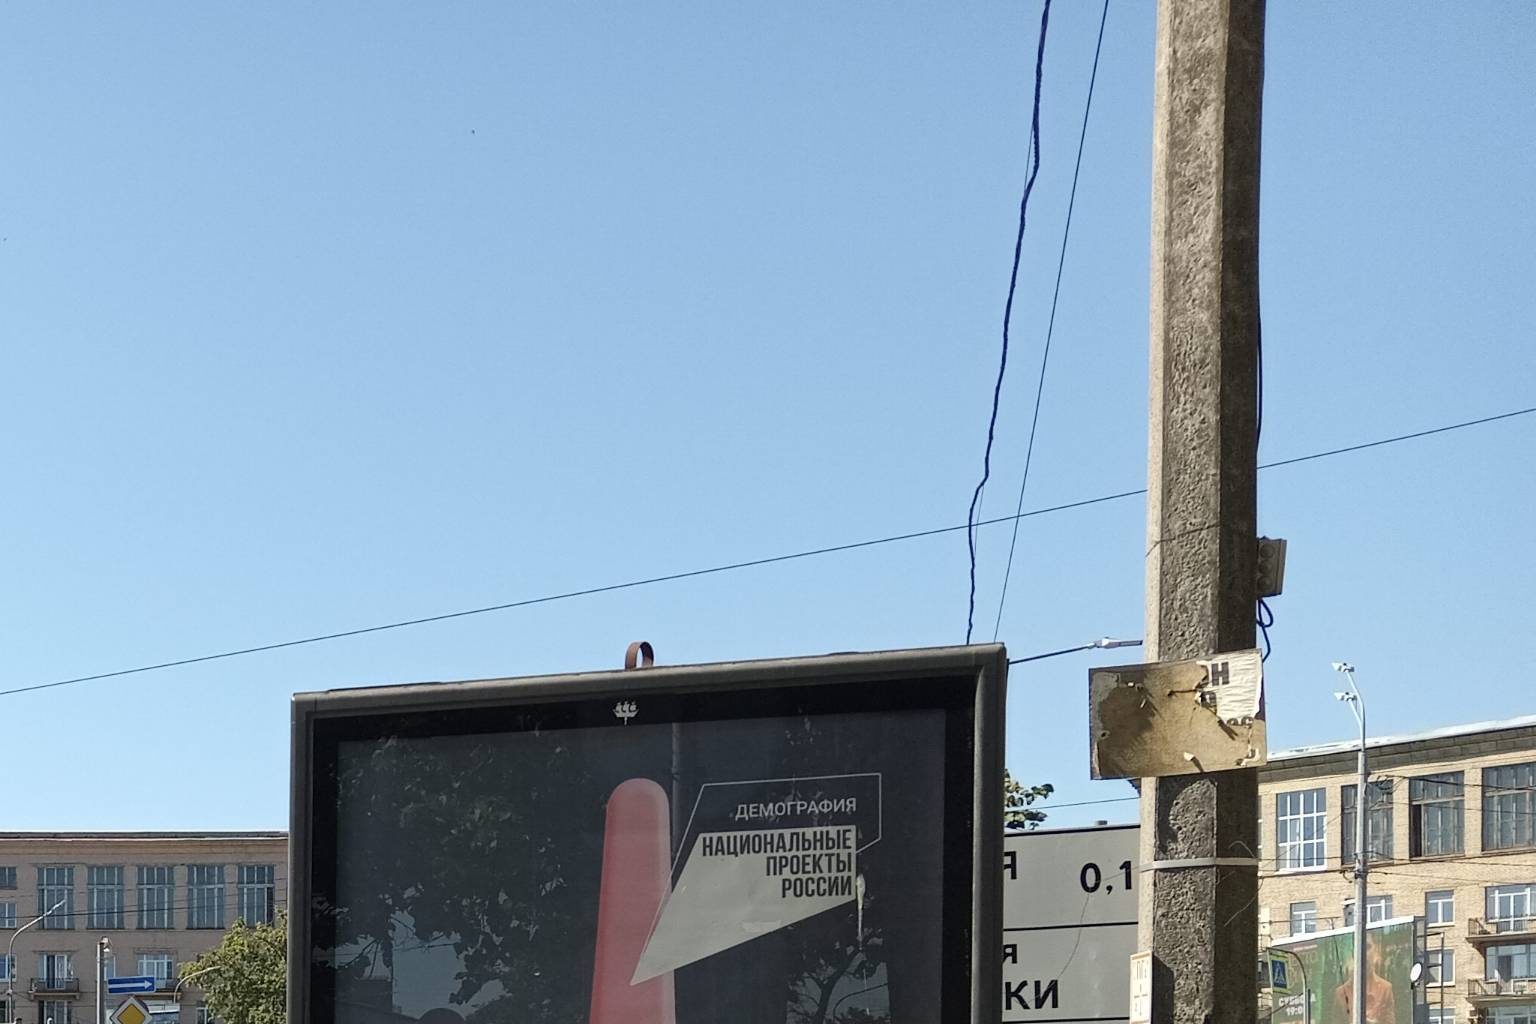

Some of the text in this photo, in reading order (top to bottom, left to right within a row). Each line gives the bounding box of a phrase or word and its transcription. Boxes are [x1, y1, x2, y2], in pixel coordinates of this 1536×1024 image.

[735, 797, 857, 821] ДЕМОГРАФИЯ
[702, 828, 853, 858] НАЦИОНАЛЬНЫЕ
[766, 853, 852, 877] ПРОЕКТЫ
[781, 875, 852, 899] РОССИИ
[1080, 860, 1132, 895] 0,1
[1286, 1006, 1304, 1016] 19:0
